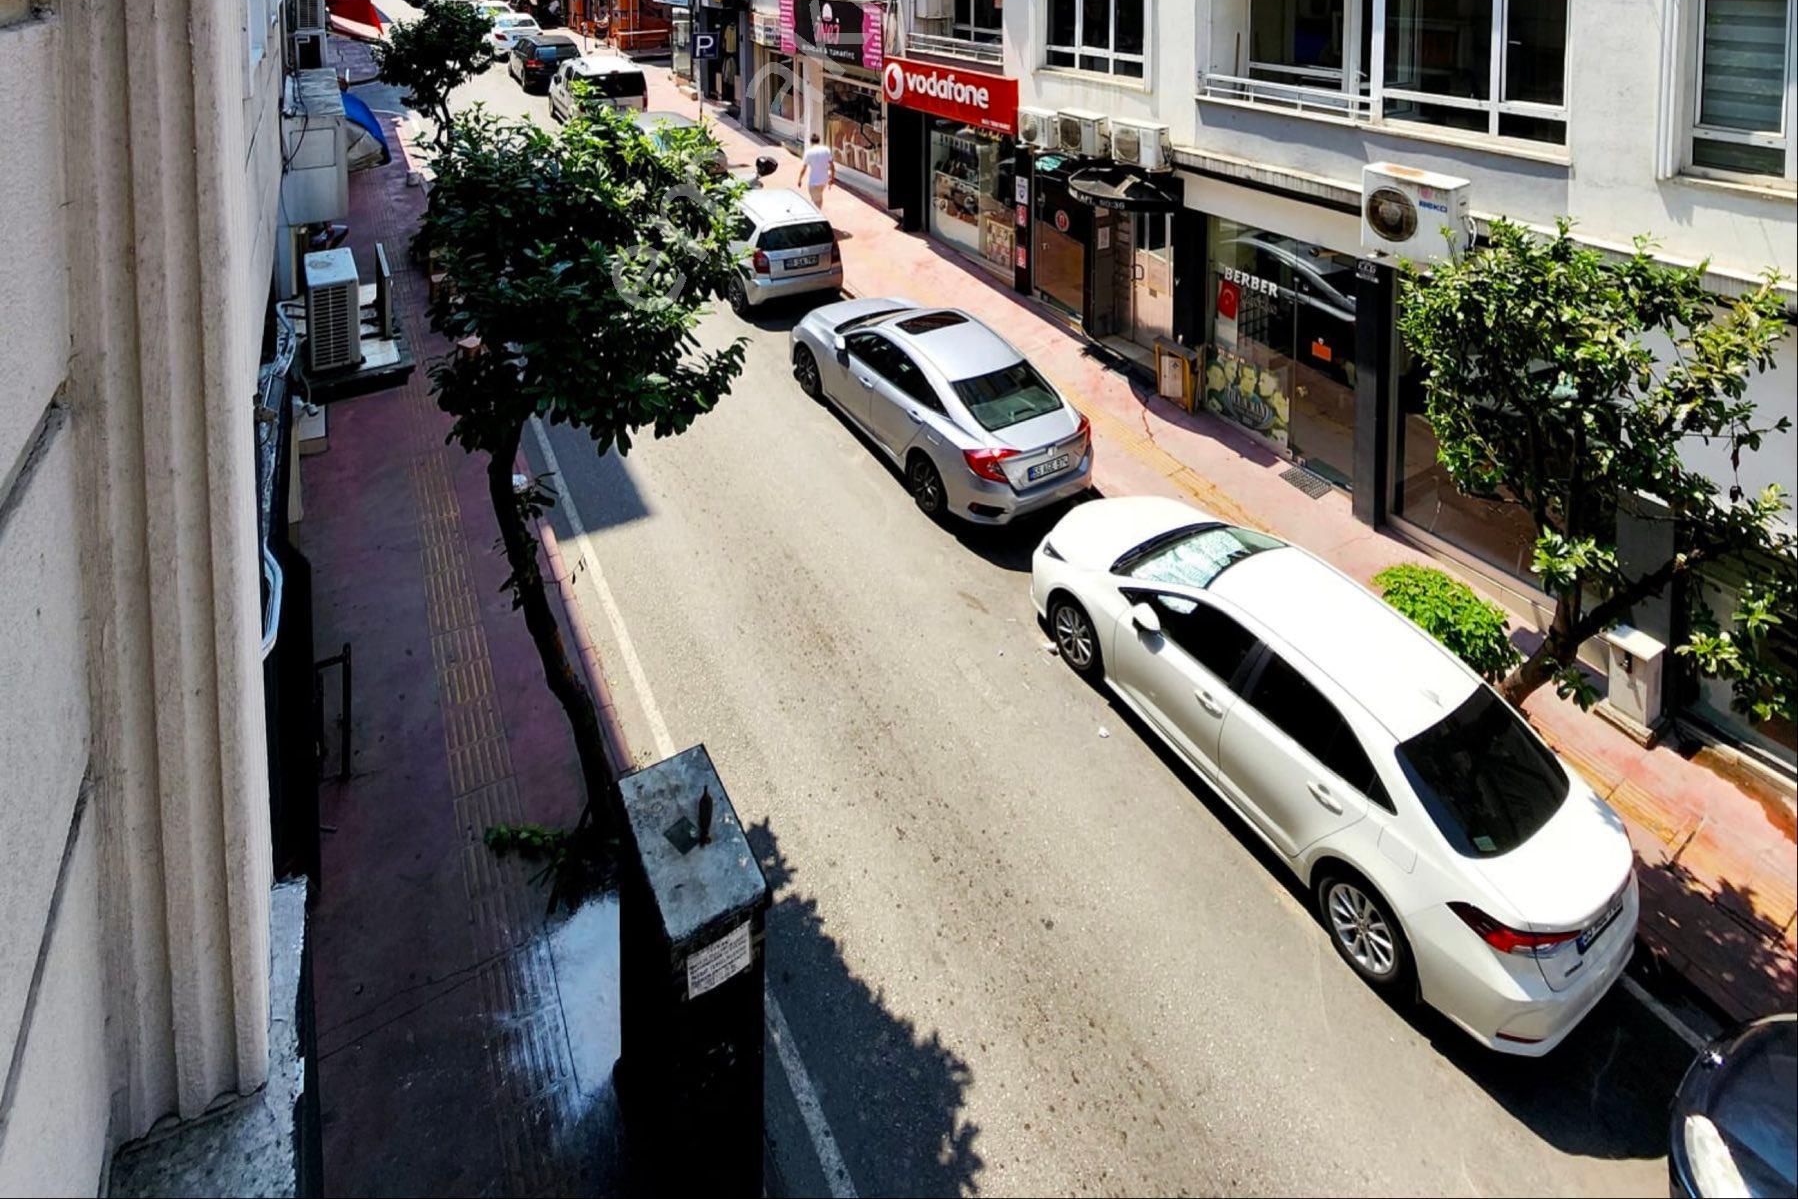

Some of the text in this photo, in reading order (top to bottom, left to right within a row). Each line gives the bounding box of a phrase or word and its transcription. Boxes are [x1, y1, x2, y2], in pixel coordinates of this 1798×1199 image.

[695, 35, 714, 57] P
[905, 70, 990, 109] vodafone
[1224, 266, 1279, 298] BERBER
